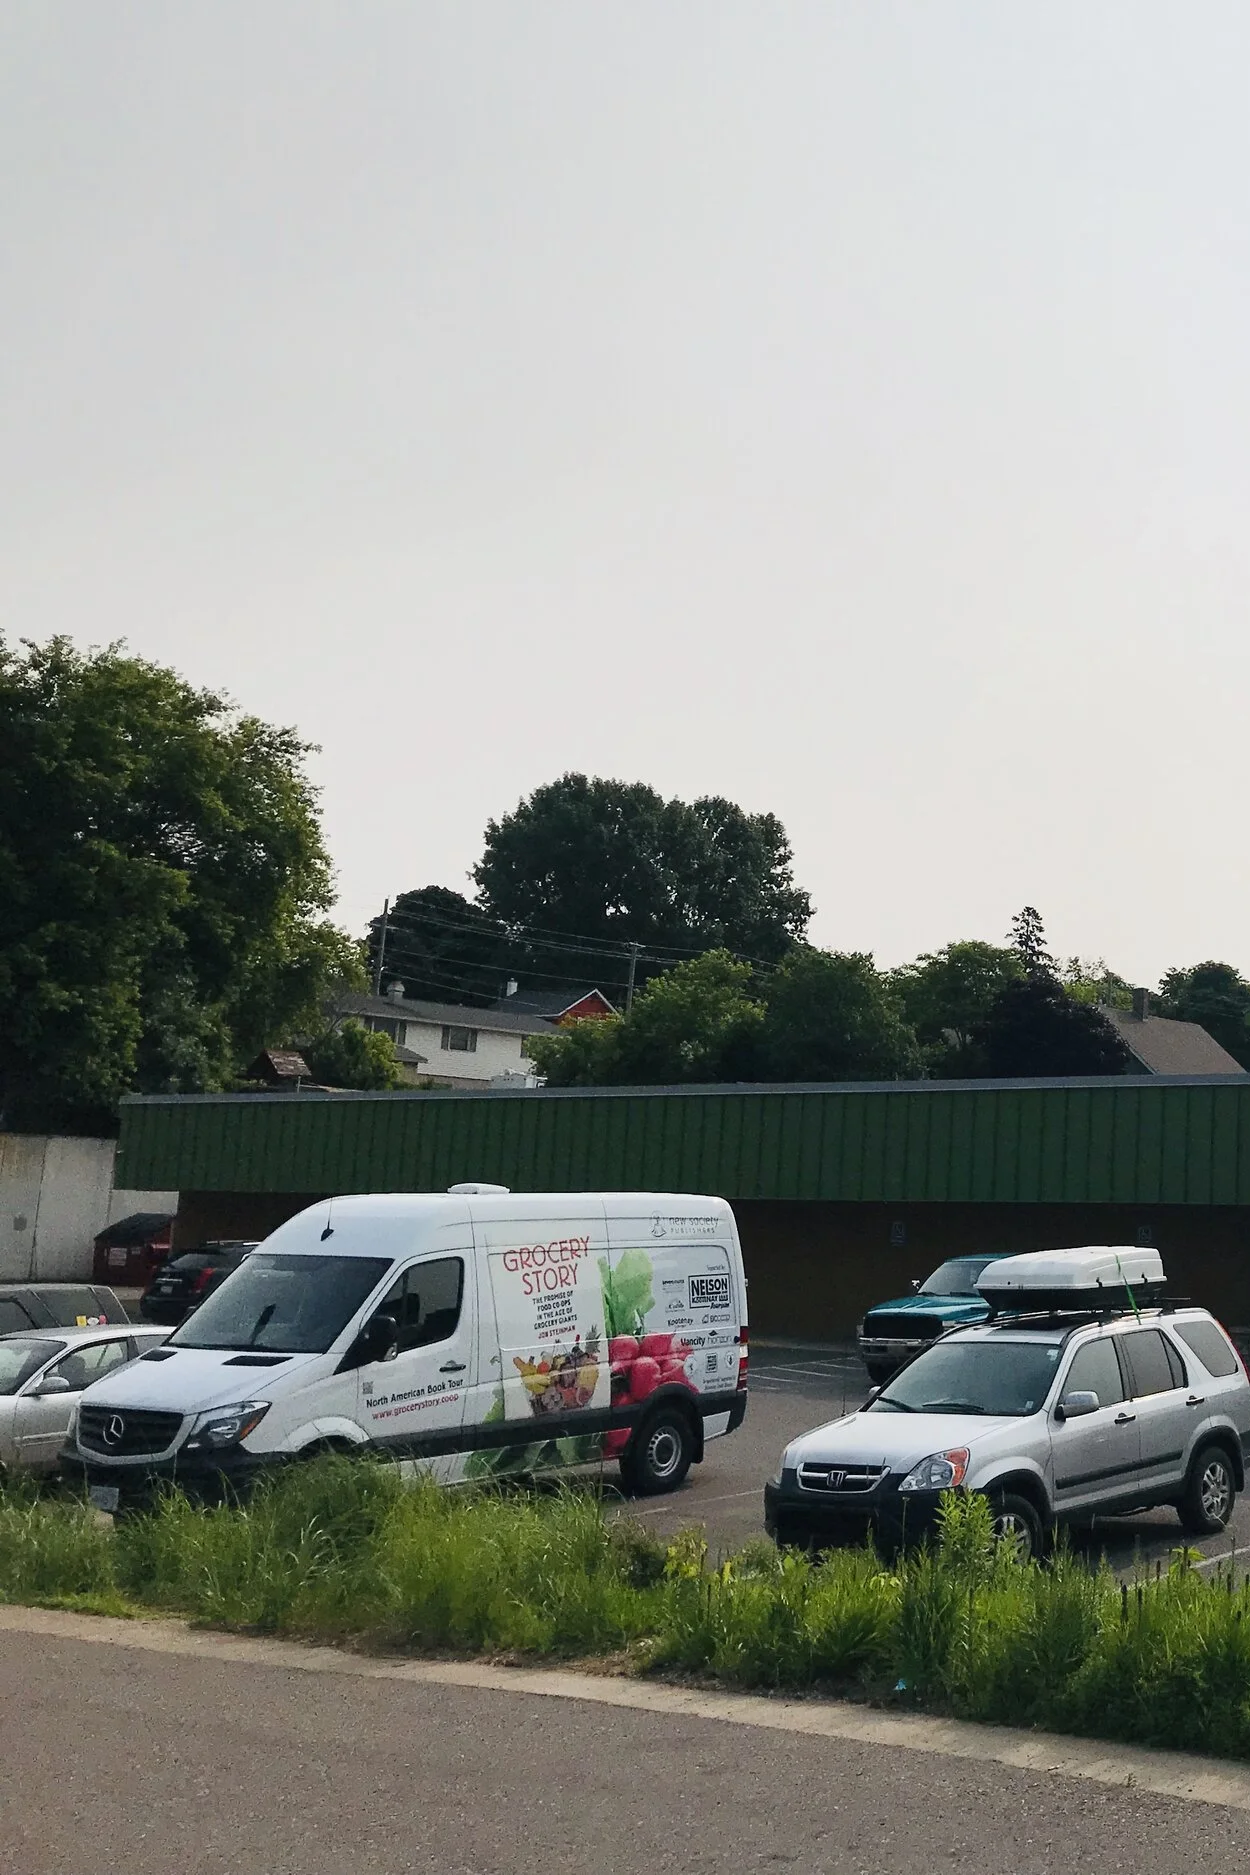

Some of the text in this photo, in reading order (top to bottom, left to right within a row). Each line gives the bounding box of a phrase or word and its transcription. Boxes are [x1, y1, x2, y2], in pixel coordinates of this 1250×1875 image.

[669, 1216, 719, 1228] new society
[503, 1236, 590, 1272] GROCERY
[522, 1263, 578, 1295] STORY
[691, 1278, 728, 1296] NELSON
[544, 1291, 566, 1302] PROMISE
[567, 1290, 573, 1298] OF
[538, 1303, 552, 1312] FOOD
[544, 1311, 554, 1319] THE
[555, 1308, 566, 1316] AGE
[534, 1314, 578, 1330] GROCERY GIANTS
[538, 1331, 549, 1339] JON
[681, 1335, 706, 1347] Vancity
[366, 1379, 464, 1408] North American Book Tour
[372, 1393, 459, 1420] www.grocerystory.coop
